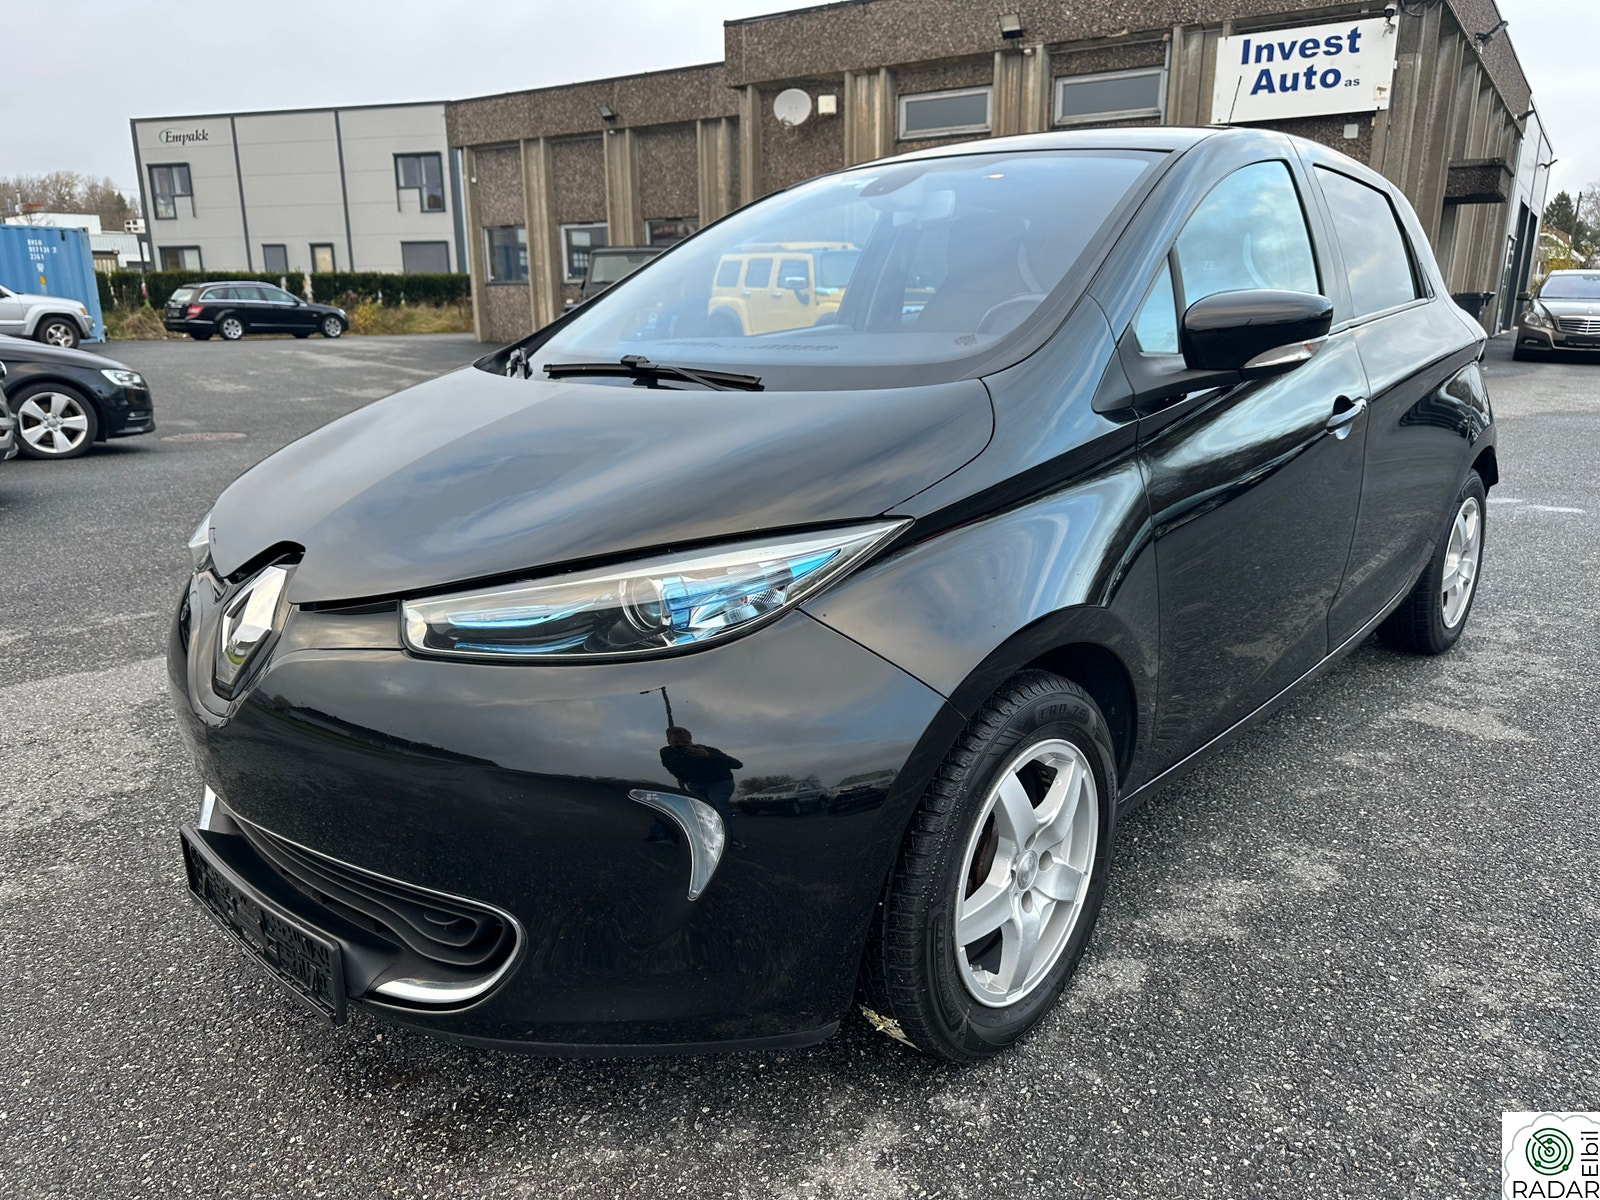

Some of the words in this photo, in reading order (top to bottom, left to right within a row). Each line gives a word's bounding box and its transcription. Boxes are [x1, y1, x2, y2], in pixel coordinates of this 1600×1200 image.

[1241, 26, 1361, 65] Invest
[1250, 64, 1341, 96] Auto
[1344, 78, 1360, 87] as
[165, 129, 209, 146] Empakk
